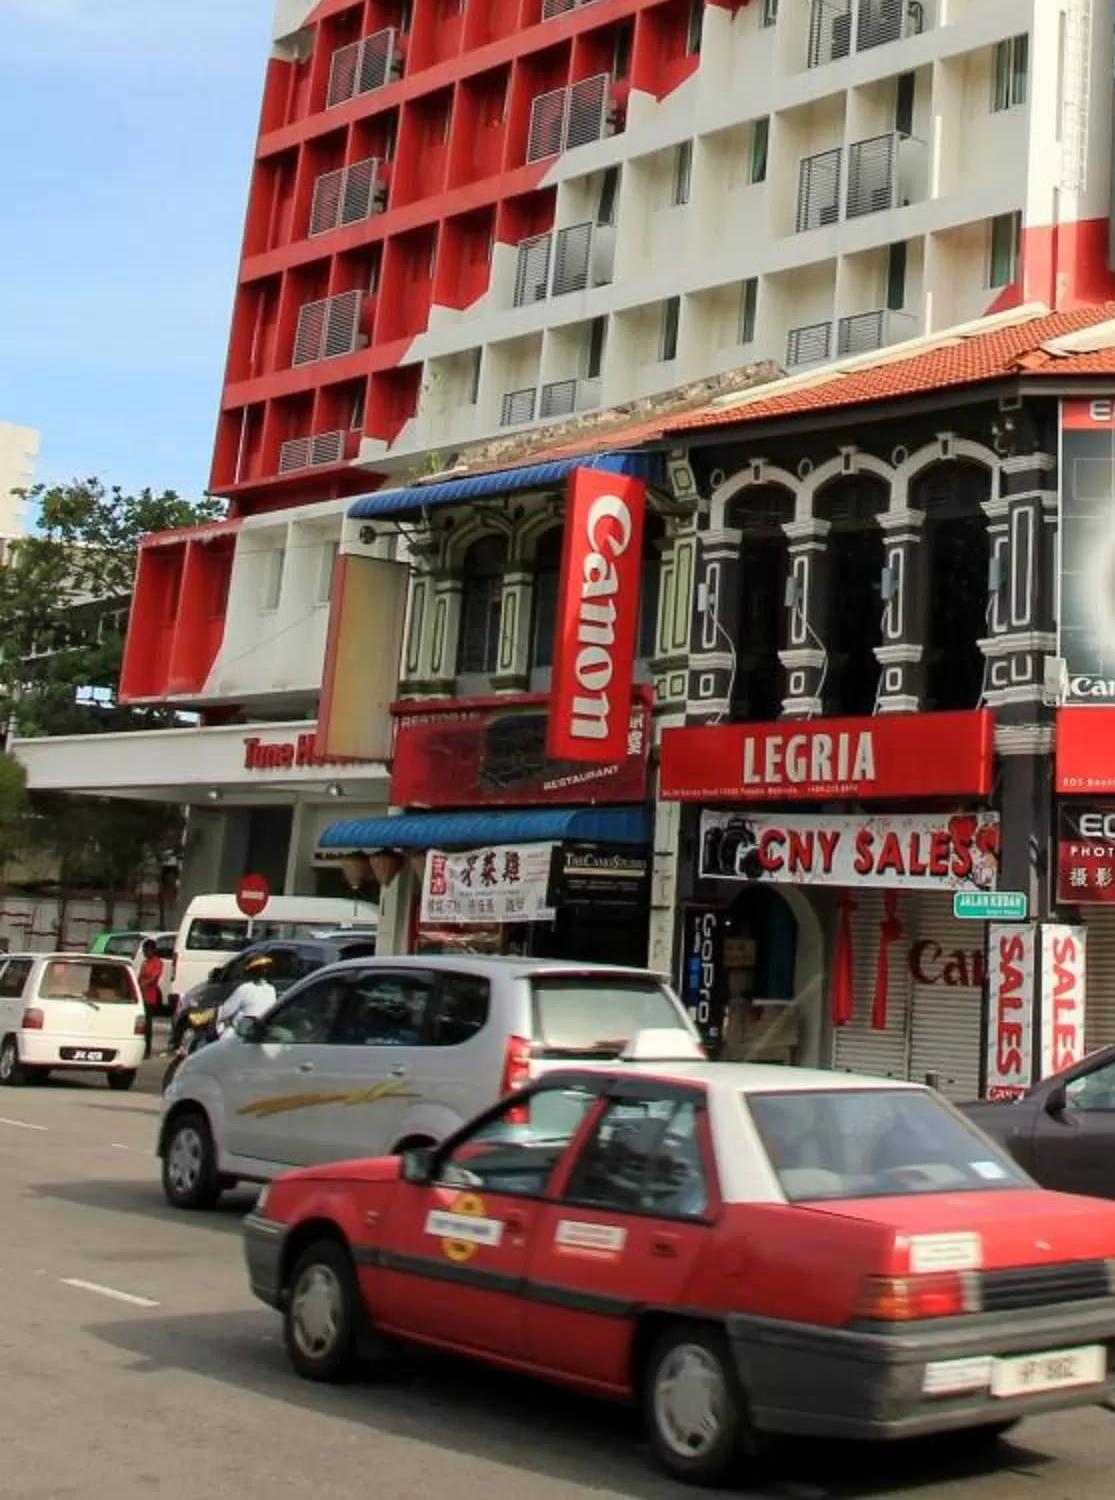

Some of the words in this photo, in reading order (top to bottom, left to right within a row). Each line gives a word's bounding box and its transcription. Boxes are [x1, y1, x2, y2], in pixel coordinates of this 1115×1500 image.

[571, 494, 632, 739] Canon
[543, 765, 619, 790] RESTAURANT
[743, 731, 876, 783] LEGRIA
[757, 828, 841, 873] CNY
[854, 827, 975, 878] SALES
[996, 934, 1024, 1075] SALES
